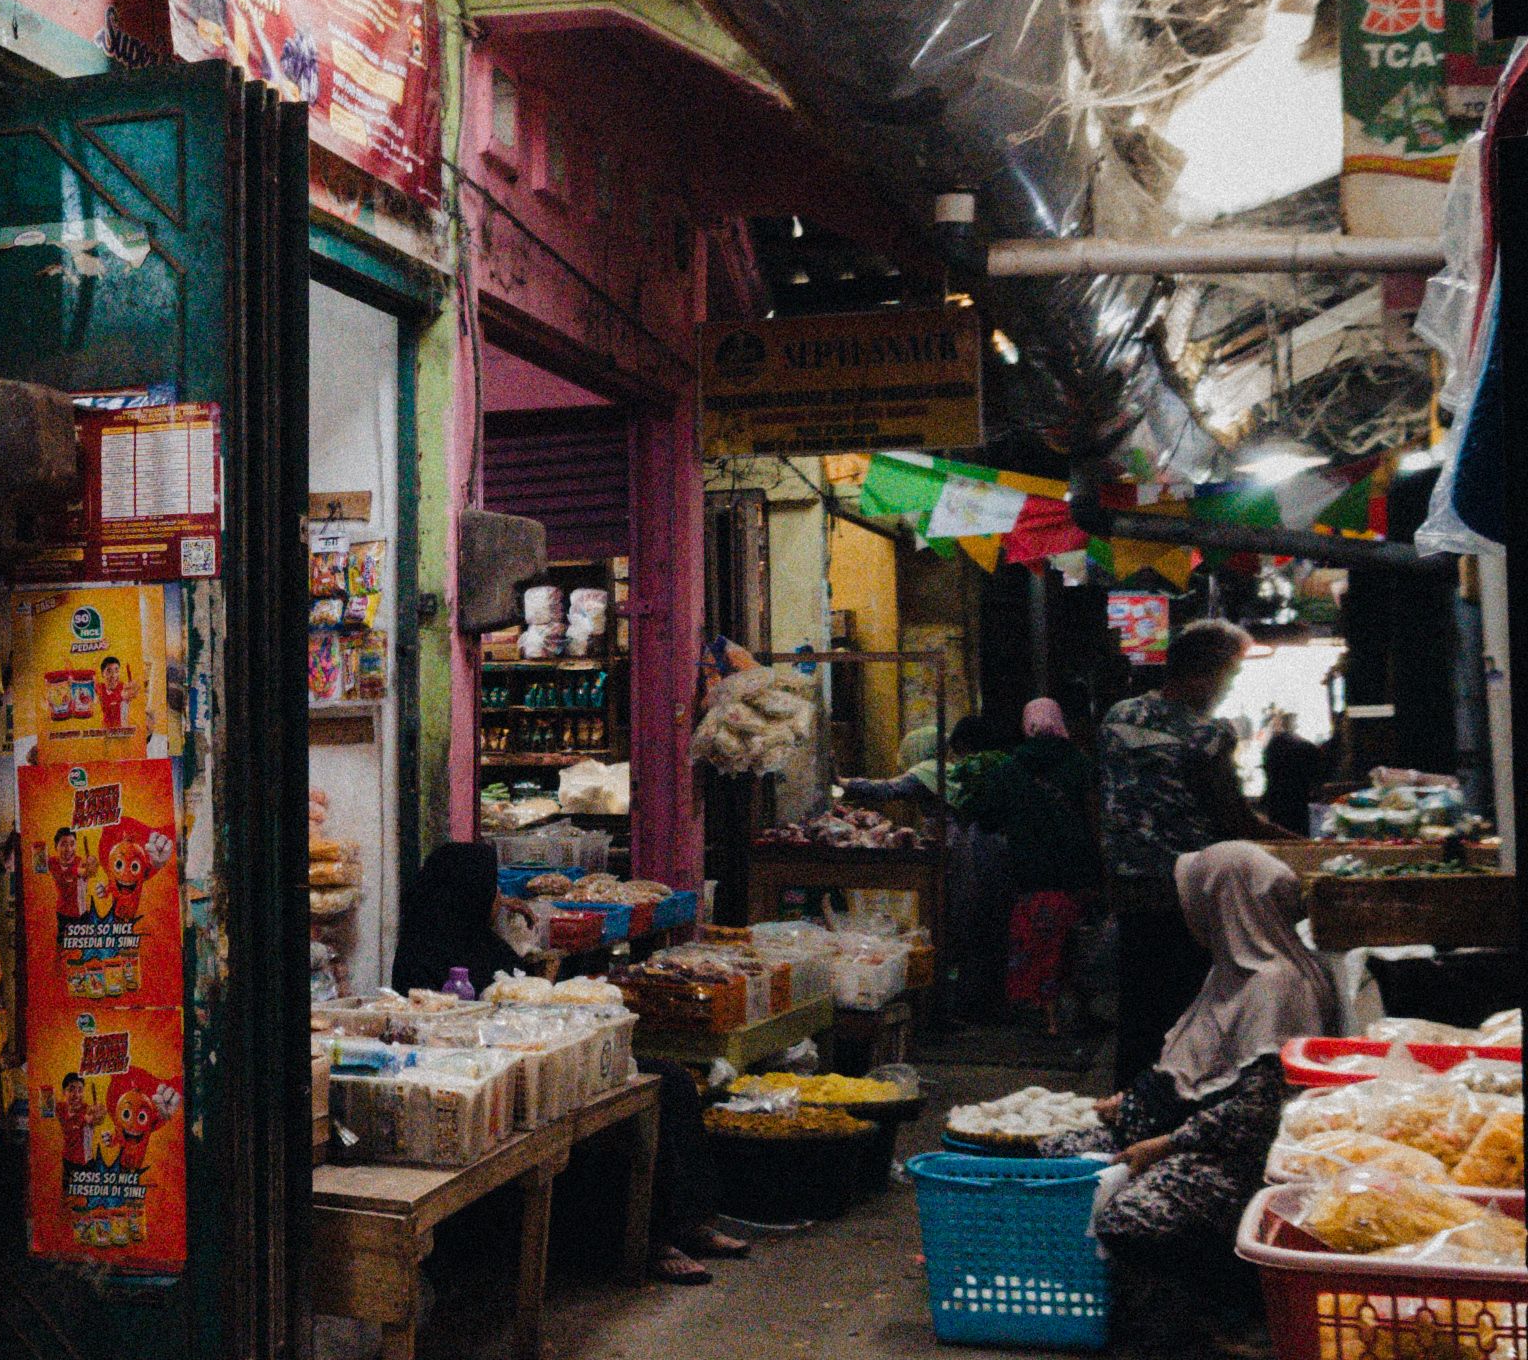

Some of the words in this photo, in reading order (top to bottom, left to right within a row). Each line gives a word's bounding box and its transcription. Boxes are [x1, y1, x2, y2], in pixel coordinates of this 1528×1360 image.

[67, 923, 95, 937] SOSIS
[97, 923, 111, 935] SO
[112, 922, 133, 935] NICE
[105, 936, 116, 949] DI
[72, 1171, 100, 1184] SOSIS
[103, 1171, 117, 1184] SO
[118, 1171, 139, 1185] NICE
[111, 1185, 122, 1197] DI
